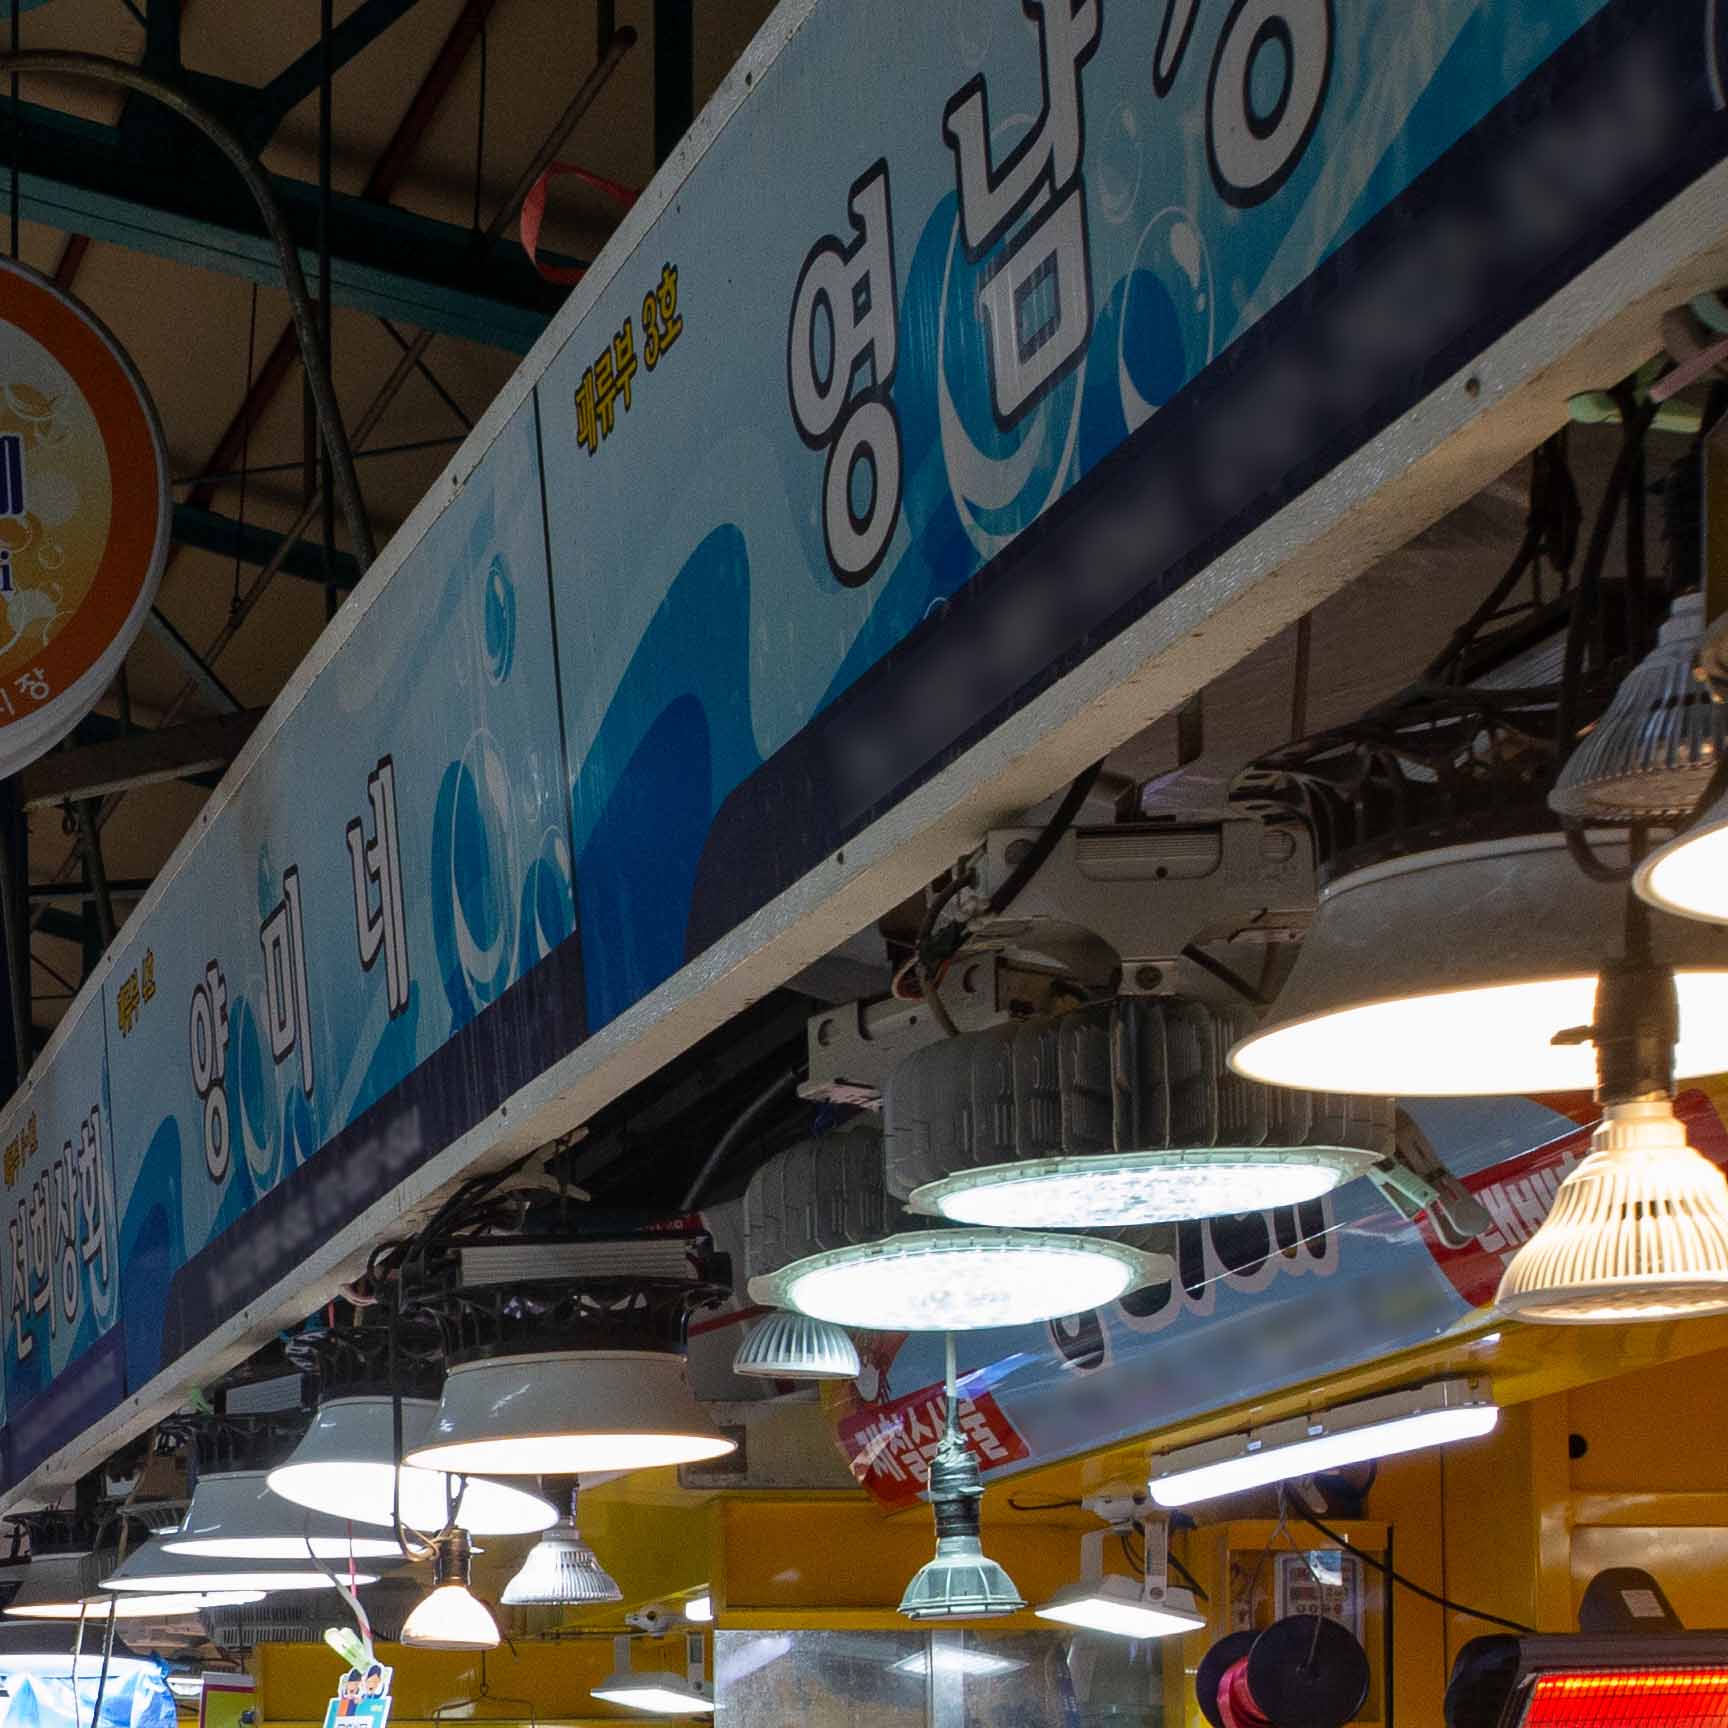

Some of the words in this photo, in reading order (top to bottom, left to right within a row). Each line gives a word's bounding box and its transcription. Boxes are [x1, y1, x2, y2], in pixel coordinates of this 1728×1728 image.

[574, 316, 636, 455] 패류부
[642, 261, 684, 372] 3호
[189, 753, 410, 1185] 양미네
